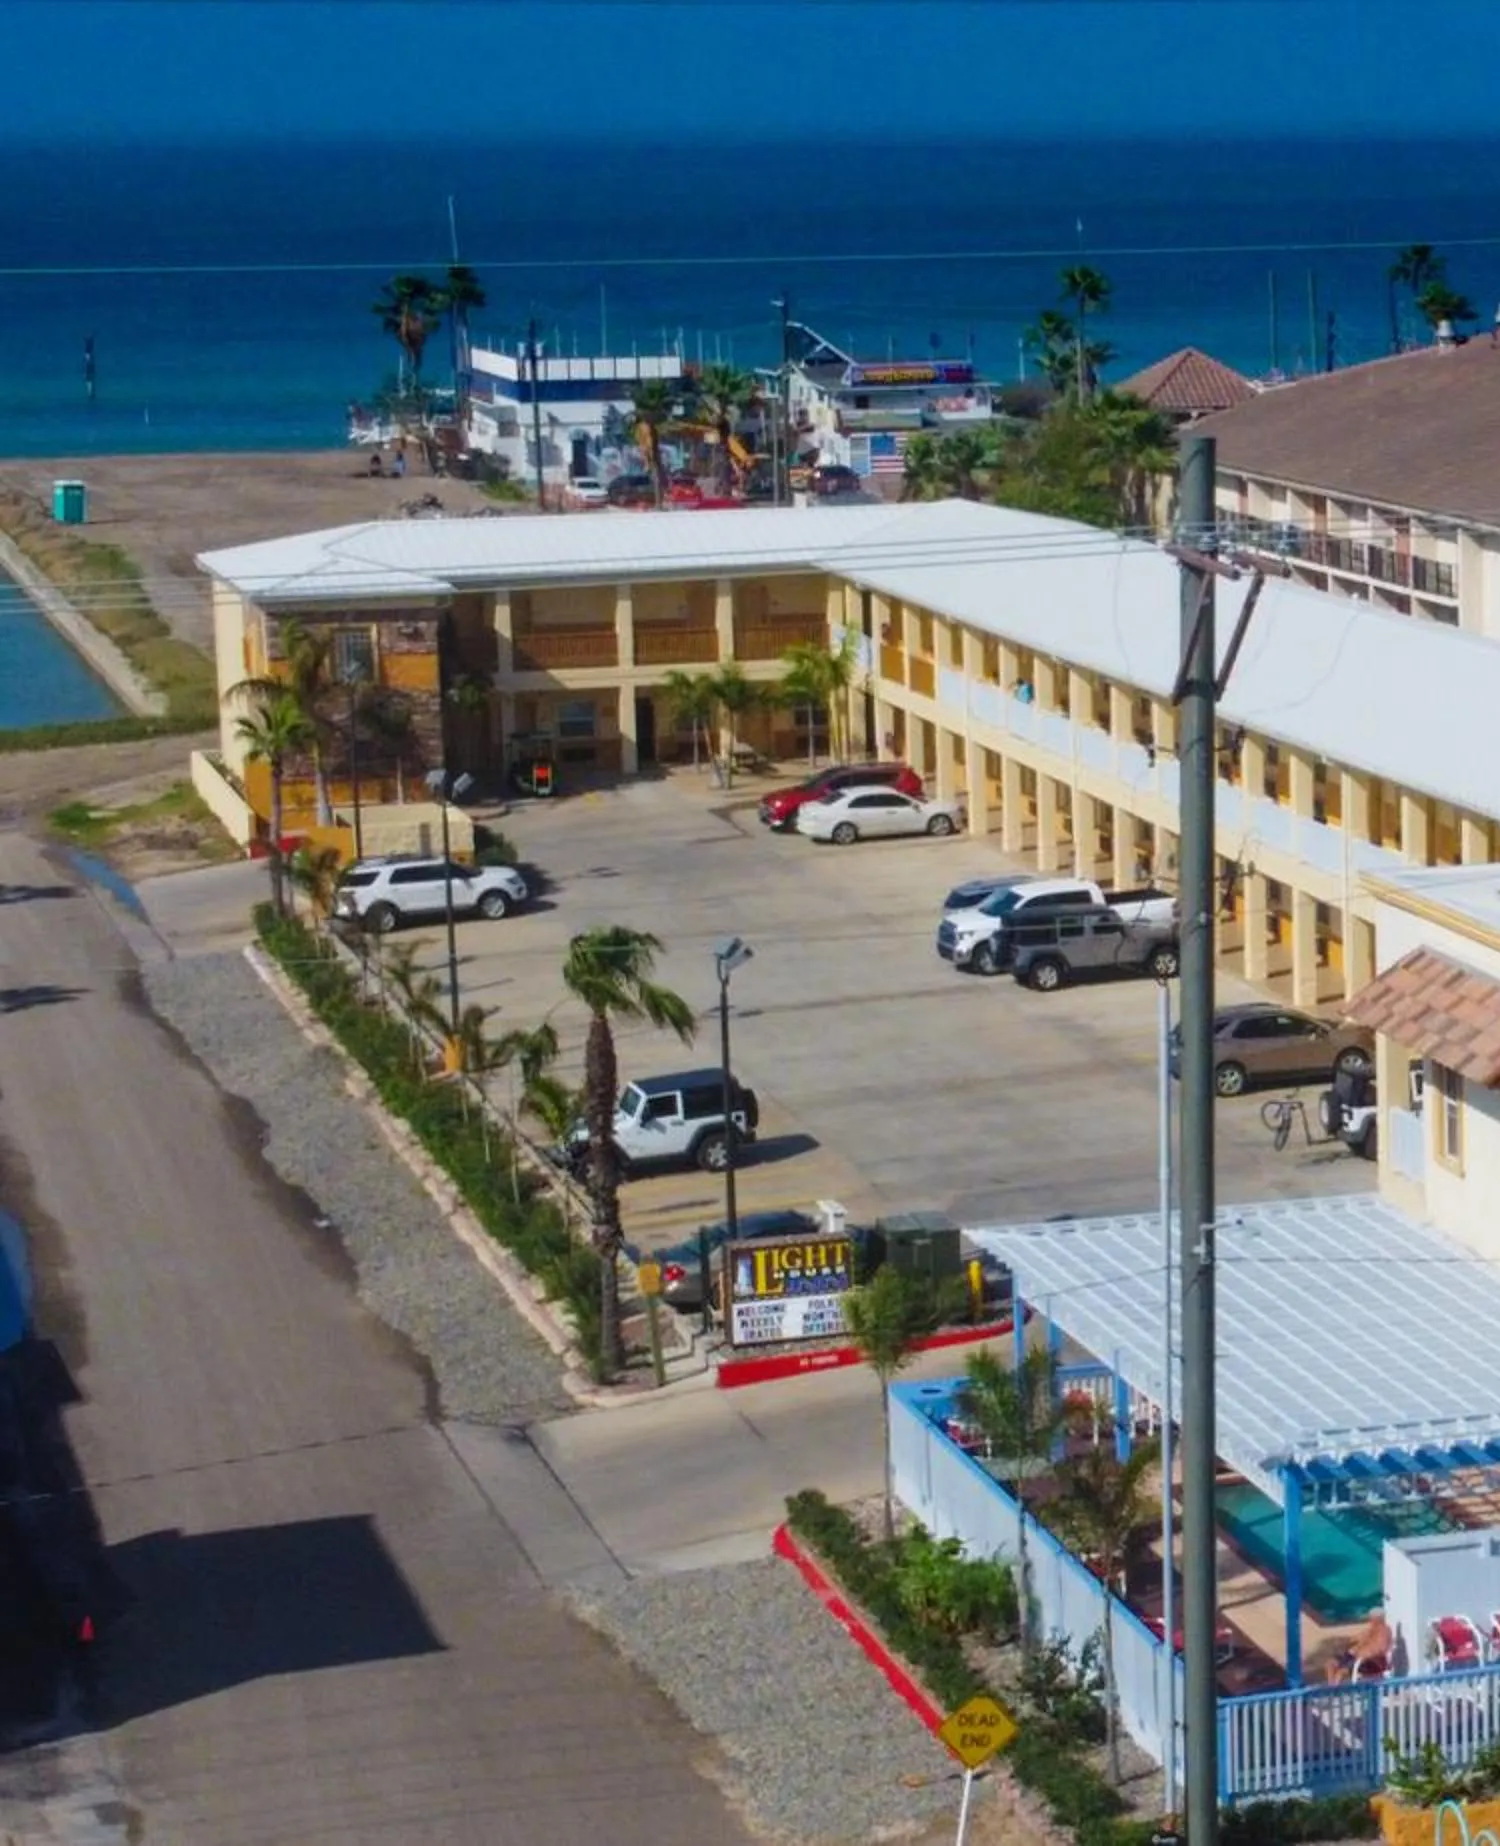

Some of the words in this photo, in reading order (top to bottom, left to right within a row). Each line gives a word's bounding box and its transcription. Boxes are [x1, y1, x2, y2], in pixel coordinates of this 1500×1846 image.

[753, 1242, 849, 1297] LIGHT
[737, 1303, 785, 1317] WELCOME
[740, 1315, 783, 1329] WEEKLY
[958, 1712, 1001, 1728] DEAD
[961, 1732, 992, 1750] END
